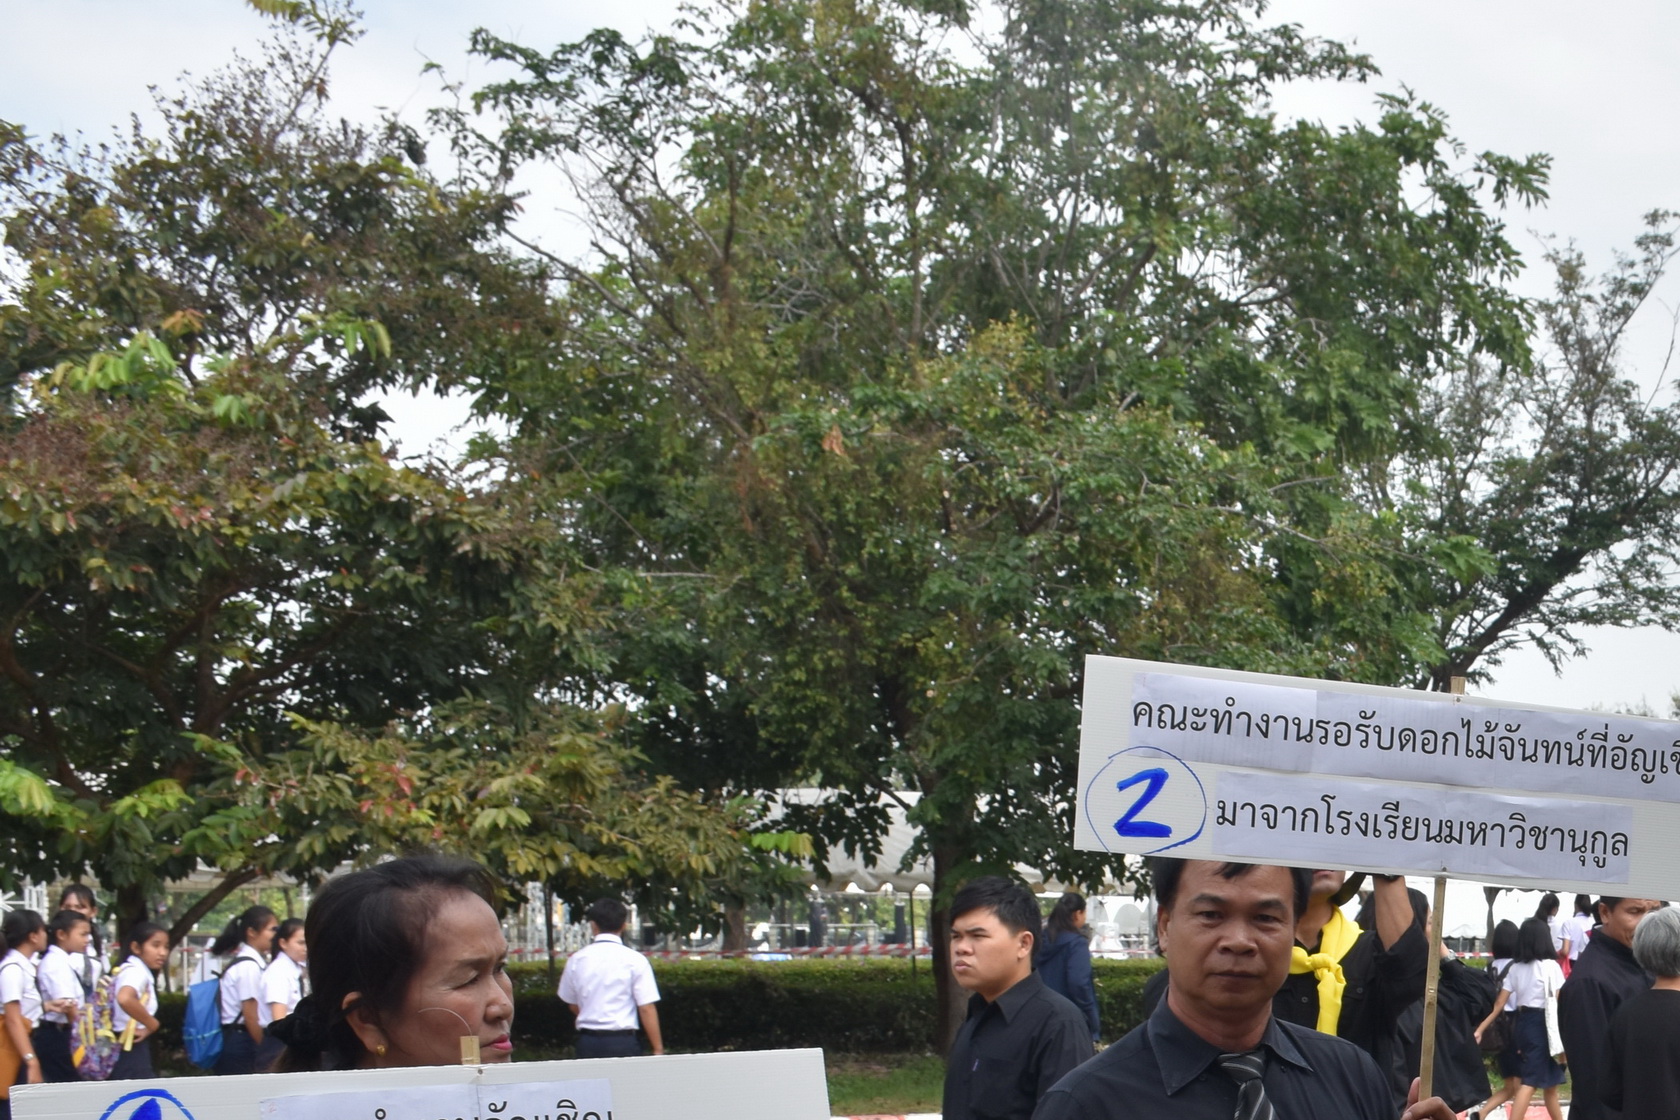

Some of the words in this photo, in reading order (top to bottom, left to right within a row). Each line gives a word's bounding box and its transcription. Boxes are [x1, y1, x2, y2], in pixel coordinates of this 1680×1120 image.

[1114, 767, 1171, 838] 2
[1216, 795, 1629, 868] มาจากโรงเรียนมหาวิชานุกูล
